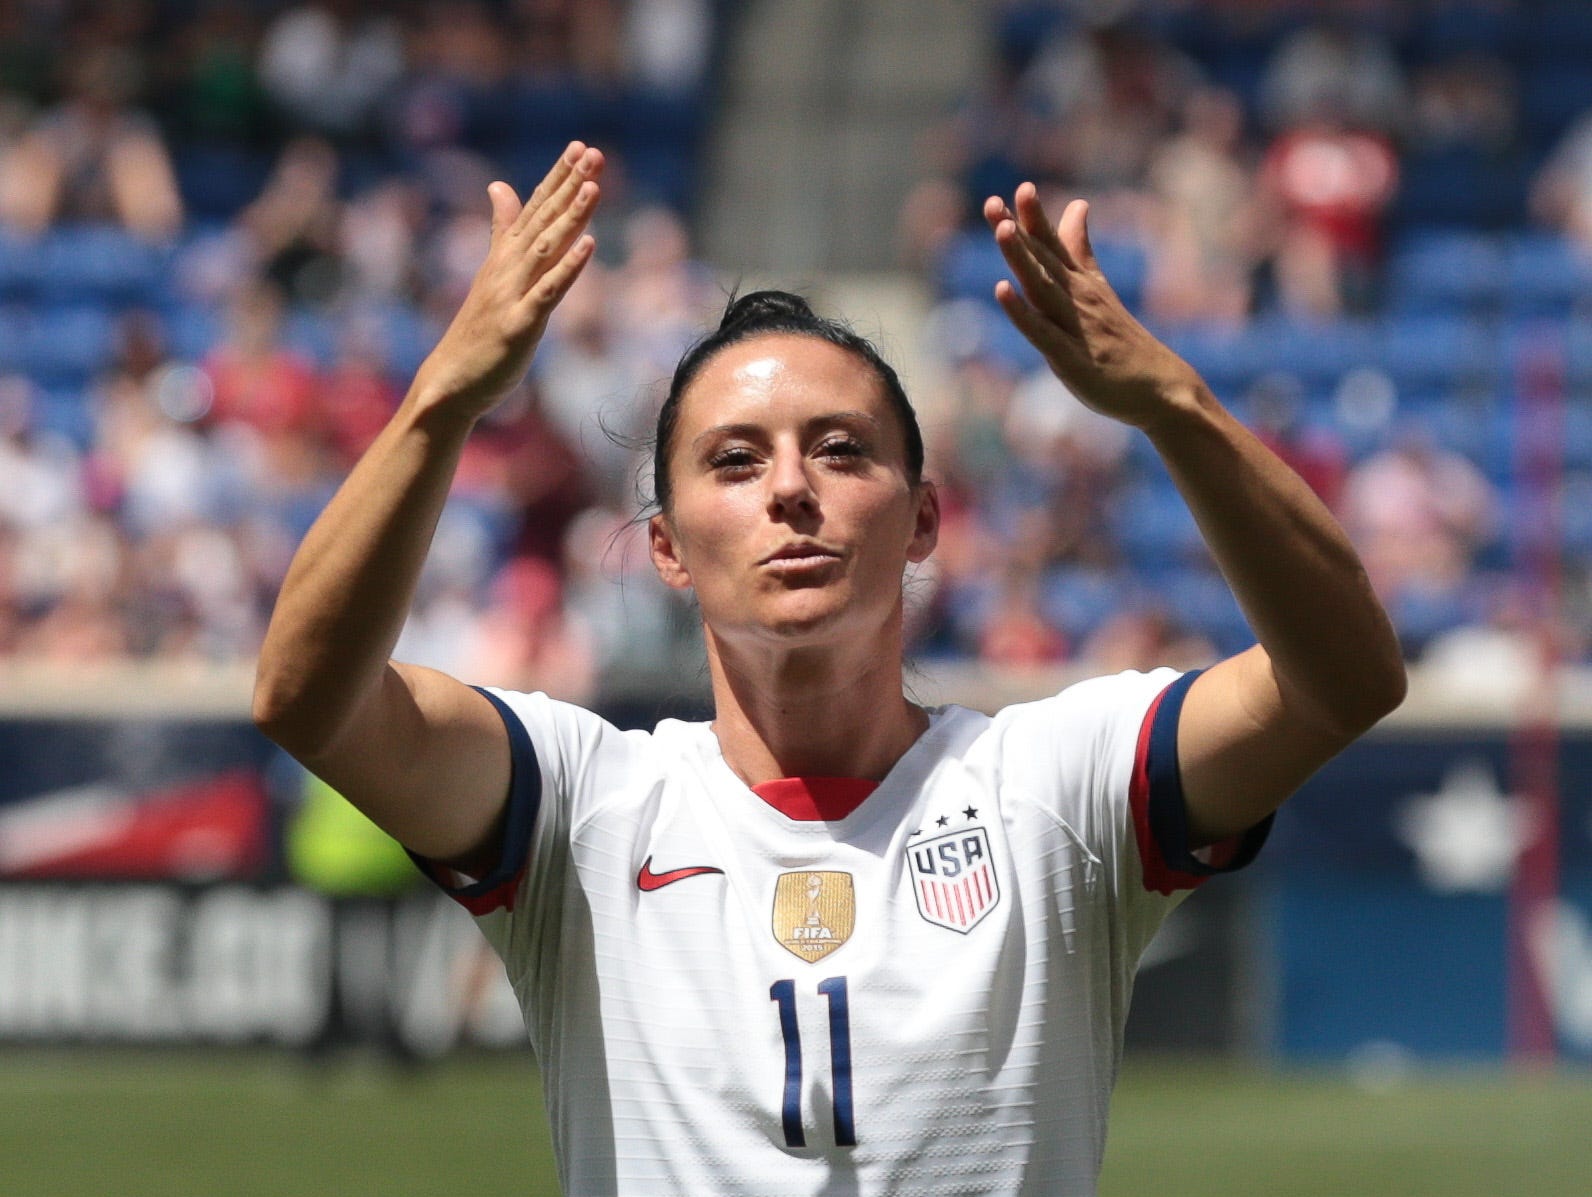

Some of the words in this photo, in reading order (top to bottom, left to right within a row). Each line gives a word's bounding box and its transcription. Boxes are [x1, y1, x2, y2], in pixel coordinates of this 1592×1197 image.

[915, 835, 983, 878] USA
[793, 927, 832, 939] FIFA
[770, 976, 856, 1147] 11
